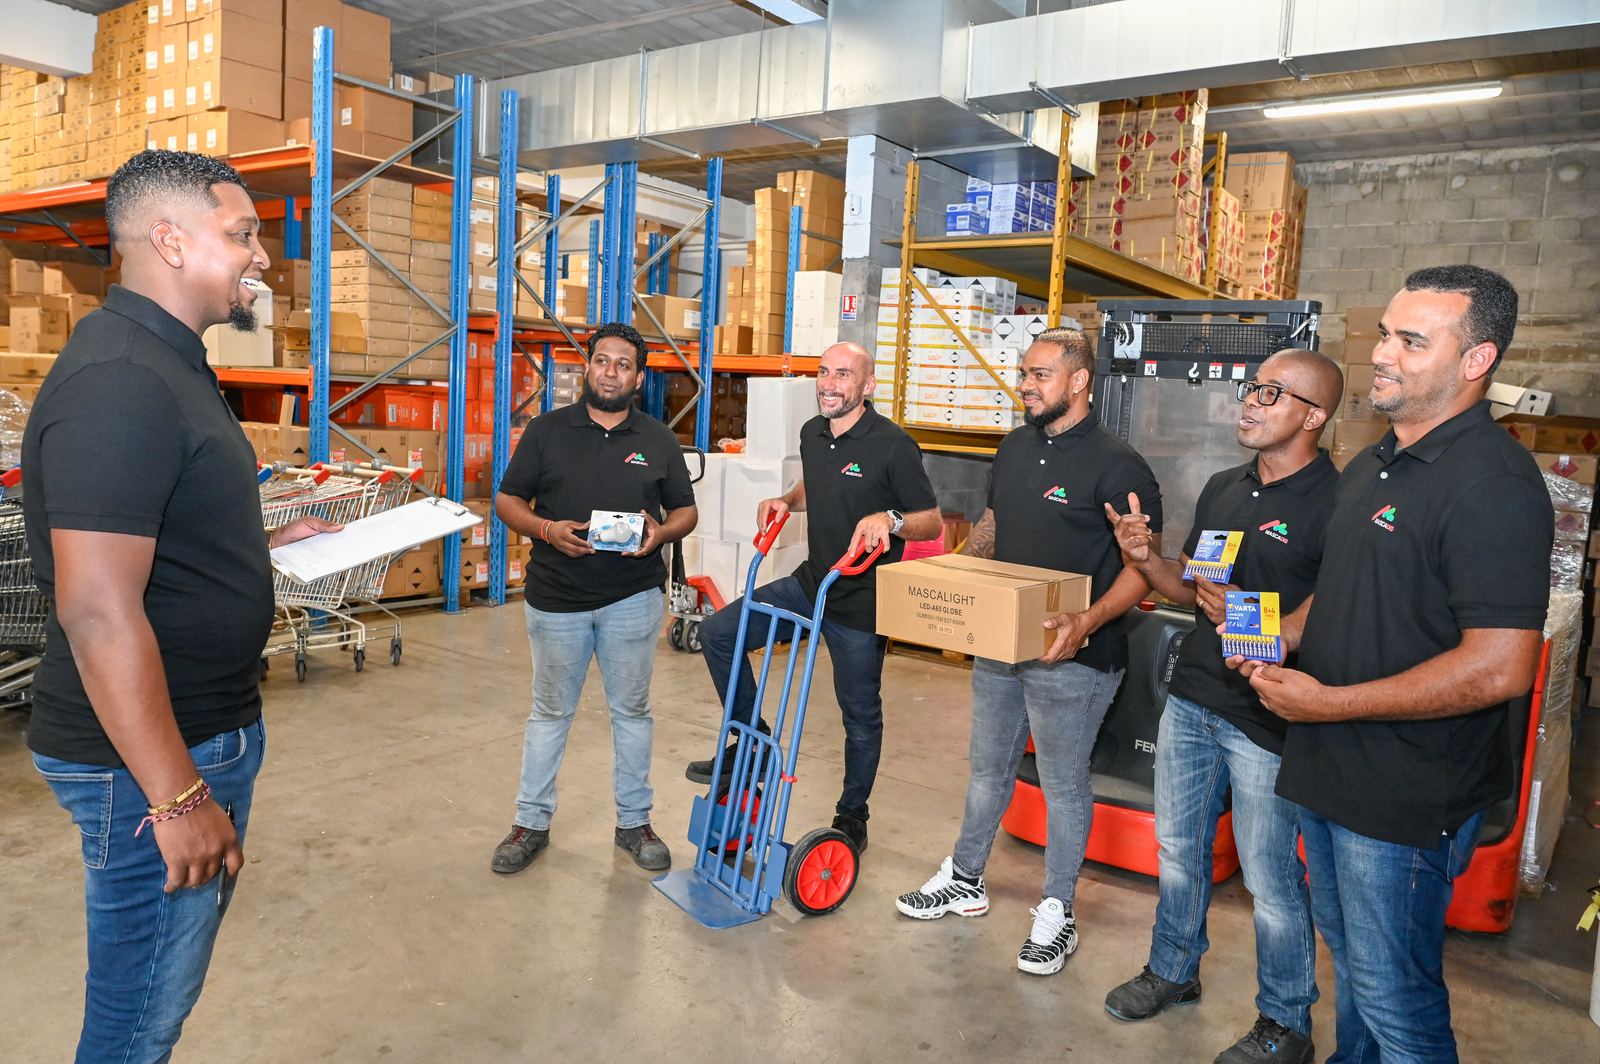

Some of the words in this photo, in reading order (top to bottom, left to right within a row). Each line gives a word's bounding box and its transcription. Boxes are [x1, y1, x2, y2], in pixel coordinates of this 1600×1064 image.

[908, 585, 976, 606] MASCALIGHT
[919, 602, 942, 612] LED-A65
[942, 606, 962, 616] GLOBE
[1134, 738, 1157, 754] FEN
